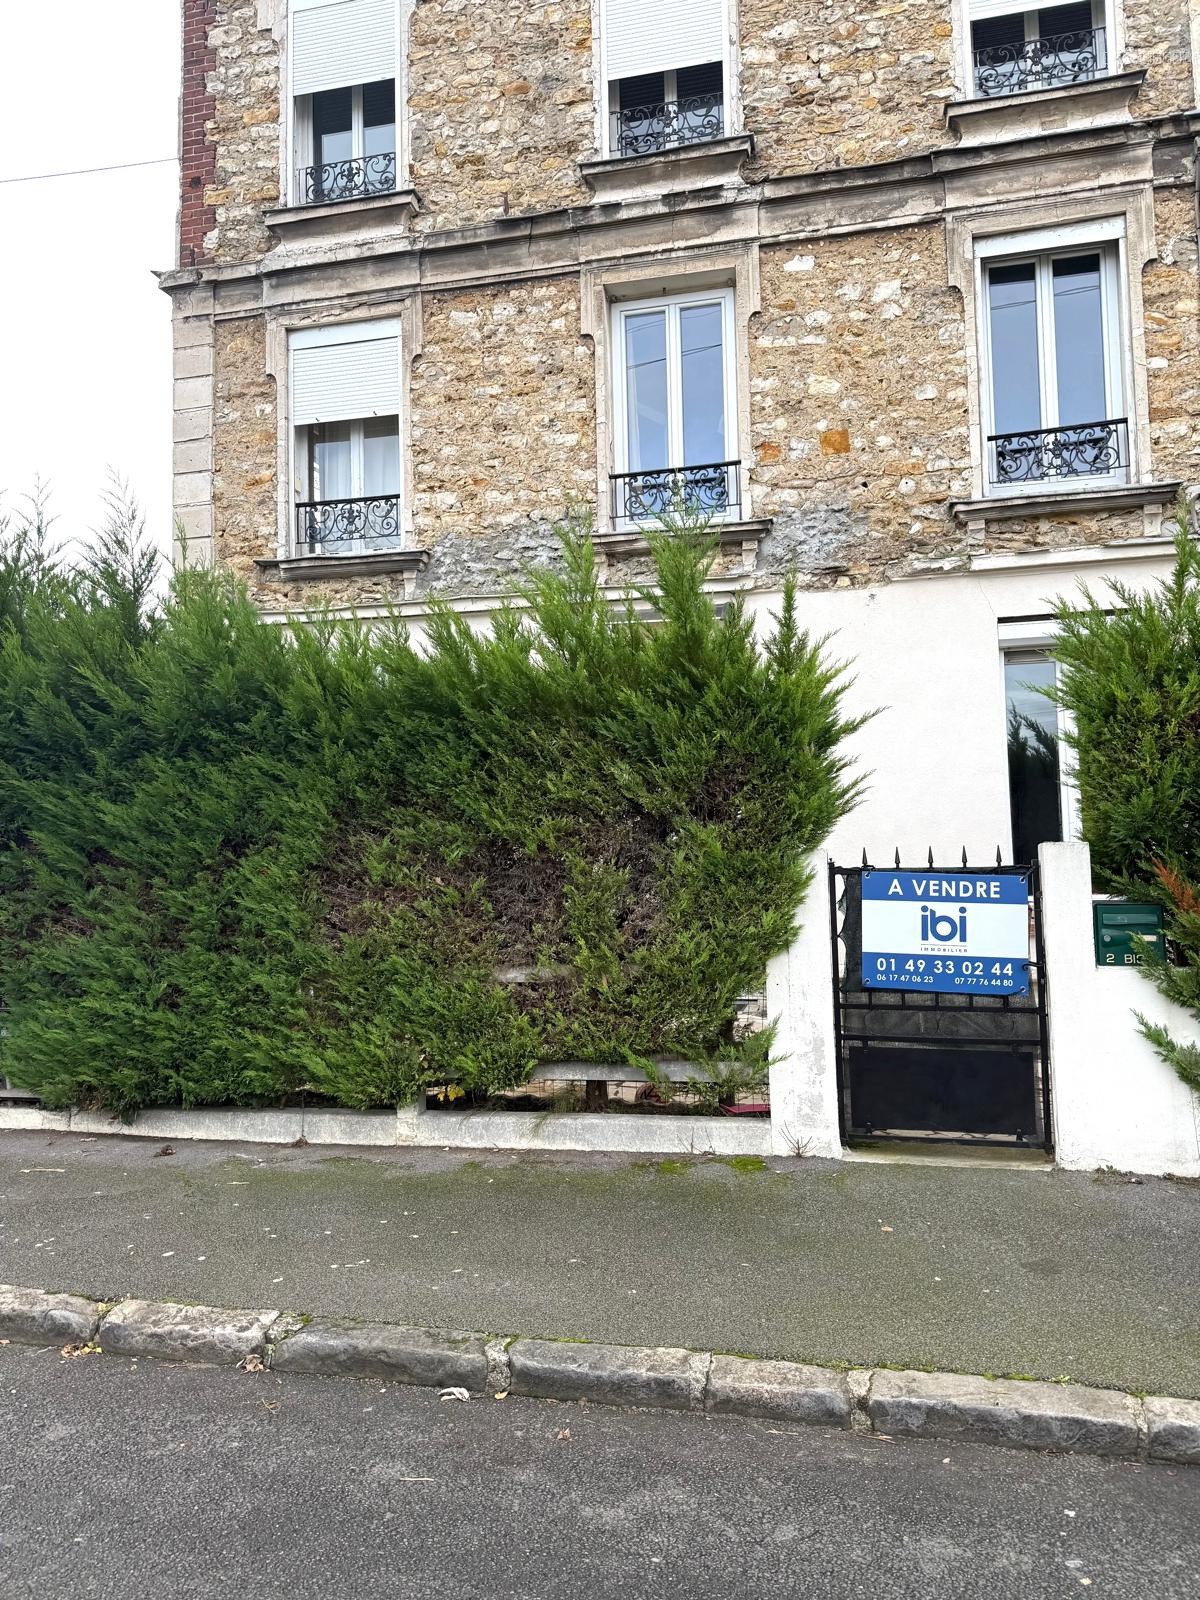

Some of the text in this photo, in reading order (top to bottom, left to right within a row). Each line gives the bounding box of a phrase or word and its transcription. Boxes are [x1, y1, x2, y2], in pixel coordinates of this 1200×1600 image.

[888, 879, 1000, 898] A VENDRE
[921, 905, 967, 942] ibi
[877, 958, 1013, 976] 01 49 33 02 44
[1106, 953, 1115, 963] 2
[955, 977, 965, 985] 07
[979, 978, 989, 986] 76
